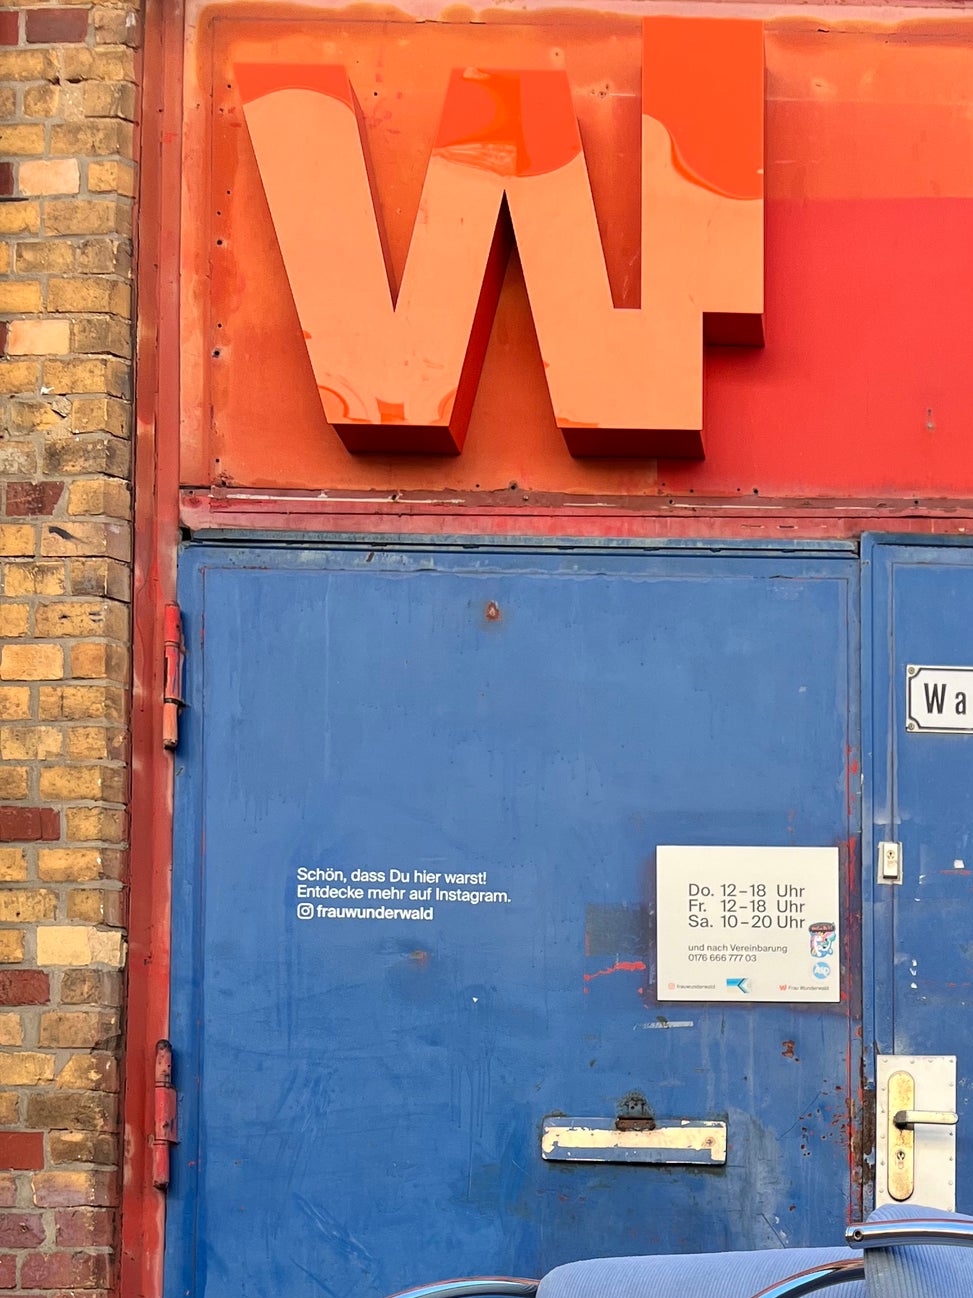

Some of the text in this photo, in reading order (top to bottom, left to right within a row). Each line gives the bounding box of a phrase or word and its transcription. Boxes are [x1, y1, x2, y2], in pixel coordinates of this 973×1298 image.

[233, 18, 766, 440] W
[297, 867, 487, 885] Schön, dass Du hier warst!
[297, 884, 512, 905] Entdecke mehr auf Instagram.
[688, 883, 714, 897] Do.
[776, 884, 805, 898] Uhr
[317, 904, 434, 920] frauwunderwald
[688, 899, 707, 912] Fr.
[776, 899, 805, 913] Uhr
[688, 914, 713, 928] Sa.
[777, 915, 806, 929] Uhr
[688, 943, 788, 954] und nach Vereinbarung
[688, 953, 757, 962] 0176 666 777 03
